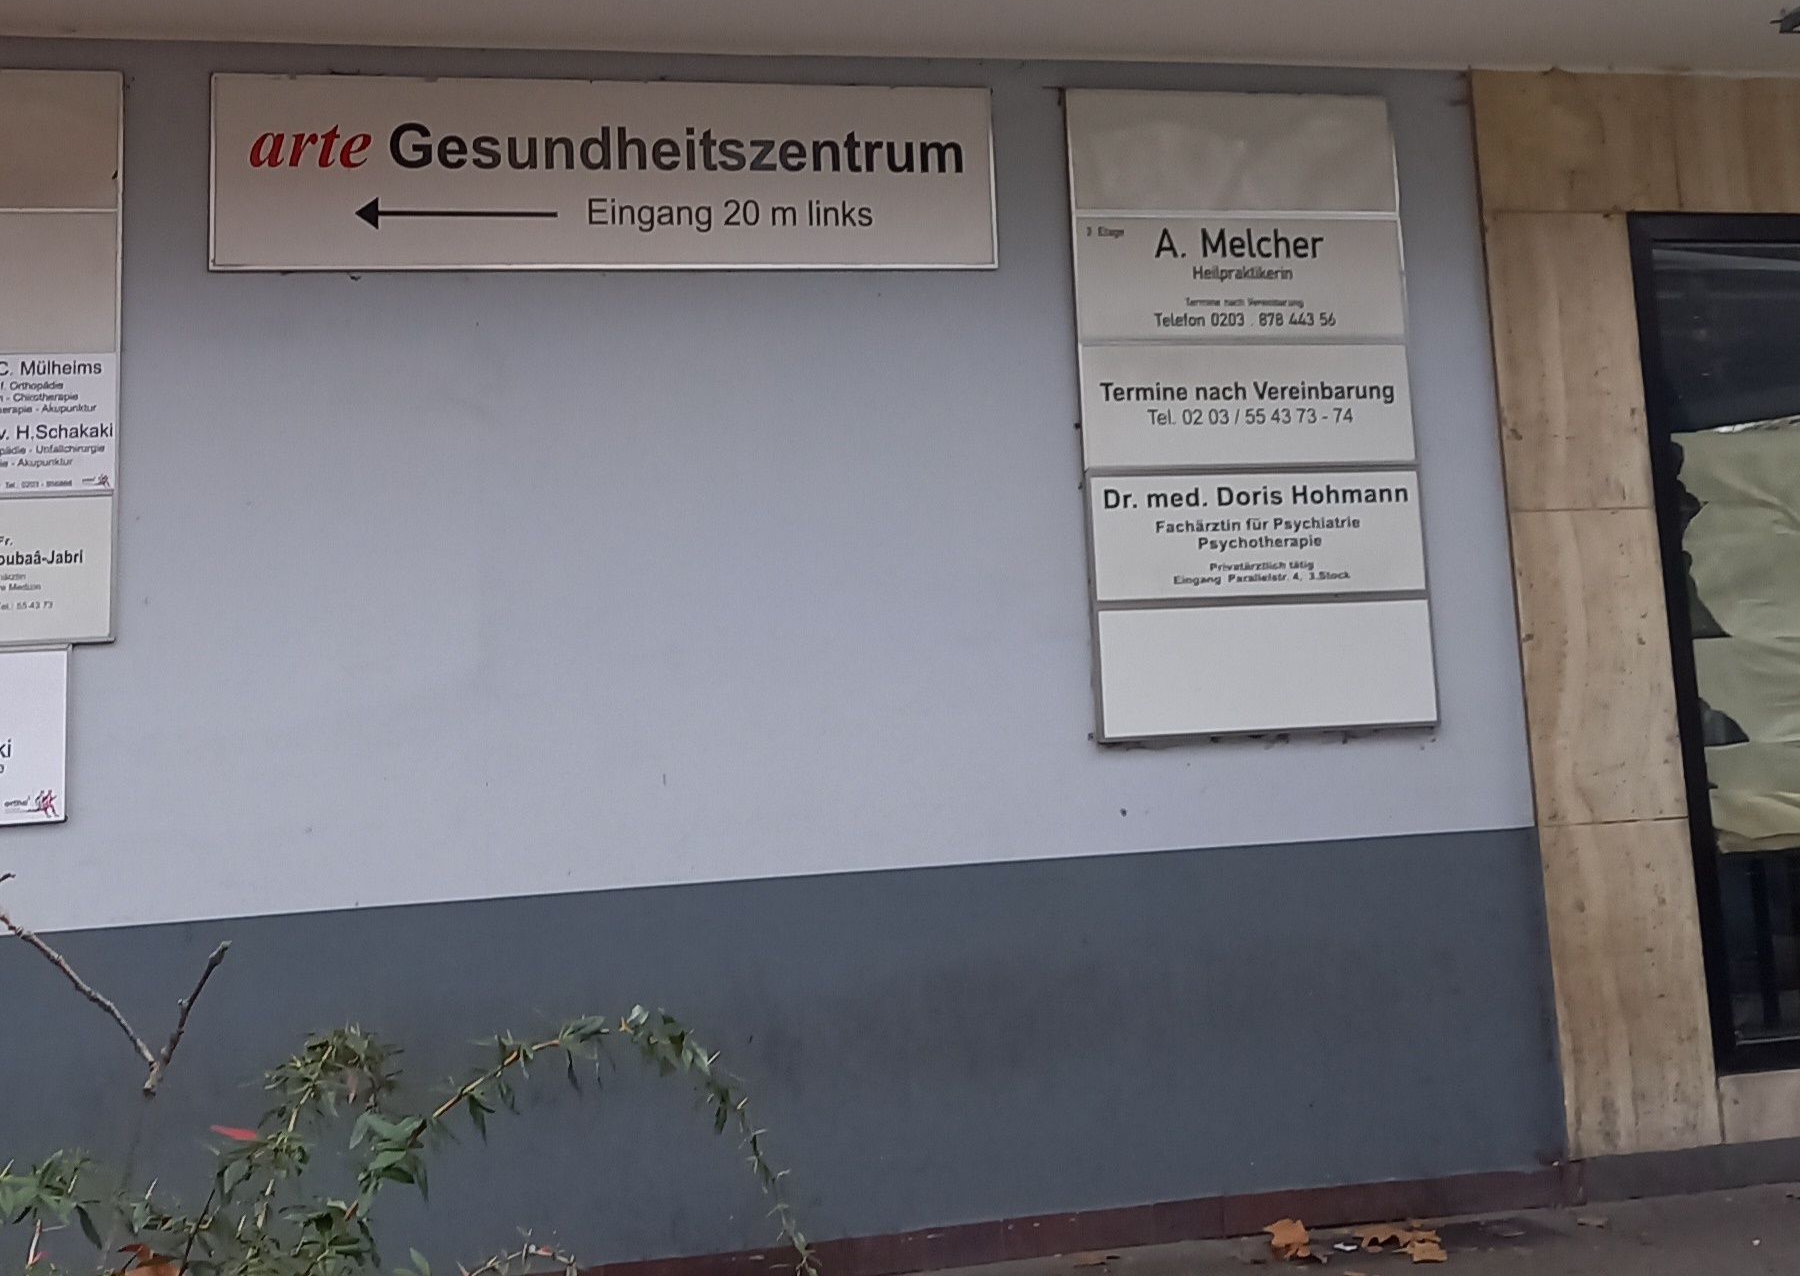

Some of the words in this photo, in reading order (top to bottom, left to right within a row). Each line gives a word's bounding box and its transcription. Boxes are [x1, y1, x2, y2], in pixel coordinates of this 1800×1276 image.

[248, 122, 372, 171] arte
[388, 121, 965, 175] Gesundheitszentrum
[588, 198, 713, 233] Eingang
[723, 199, 761, 228] 20
[771, 207, 797, 228] m
[808, 197, 873, 228] links
[1155, 228, 1187, 259] A.
[1201, 228, 1324, 259] Melcher
[1192, 265, 1293, 282] Heilpraktikerin
[1154, 312, 1205, 327] Telefon
[1210, 313, 1244, 327] 0203
[1259, 312, 1283, 327] 878
[1288, 312, 1314, 327] 443
[1319, 312, 1336, 326] 56
[21, 360, 102, 376] Mülheims
[1099, 382, 1188, 402] Termine
[1195, 381, 1247, 401] nach
[1254, 380, 1395, 405] Vereinbarung
[1147, 409, 1176, 426] Tel.
[1183, 409, 1203, 425] 02
[1208, 408, 1229, 425] 03
[1245, 408, 1265, 425] 55
[1270, 408, 1292, 424] 43
[1296, 408, 1317, 424] 73
[1332, 407, 1354, 424] 74
[1104, 488, 1138, 509] Dr.
[1147, 487, 1208, 508] med.
[1217, 485, 1283, 507] Doris
[1293, 484, 1409, 505] Hohmann
[1155, 519, 1241, 534] Fachärztin
[1246, 517, 1269, 531] für
[1273, 516, 1361, 532] Psychiatrie
[1198, 534, 1322, 552] Psychotherapie
